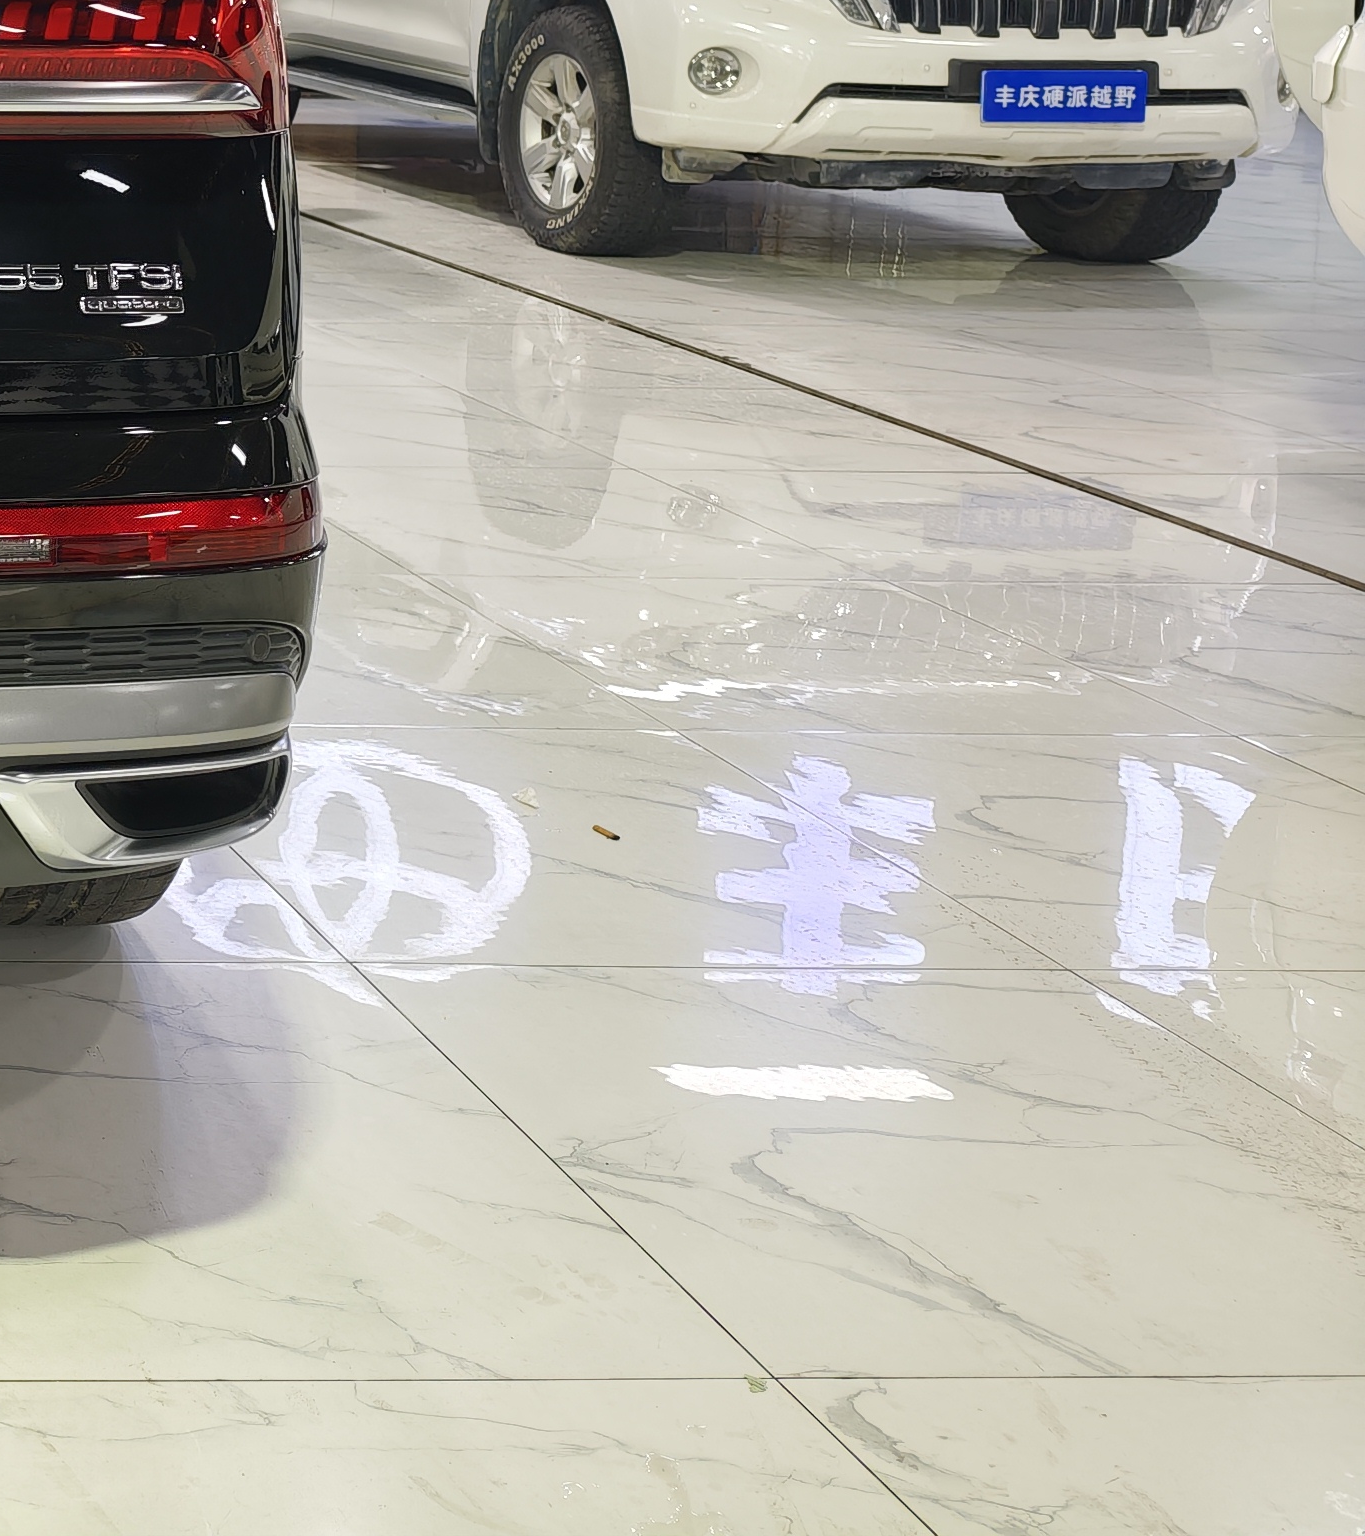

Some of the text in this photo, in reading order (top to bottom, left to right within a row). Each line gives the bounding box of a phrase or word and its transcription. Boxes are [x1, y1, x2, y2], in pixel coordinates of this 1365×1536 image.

[994, 84, 1137, 109] 丰庆硬派越野
[73, 262, 184, 291] TFSI
[83, 297, 182, 314] quattro
